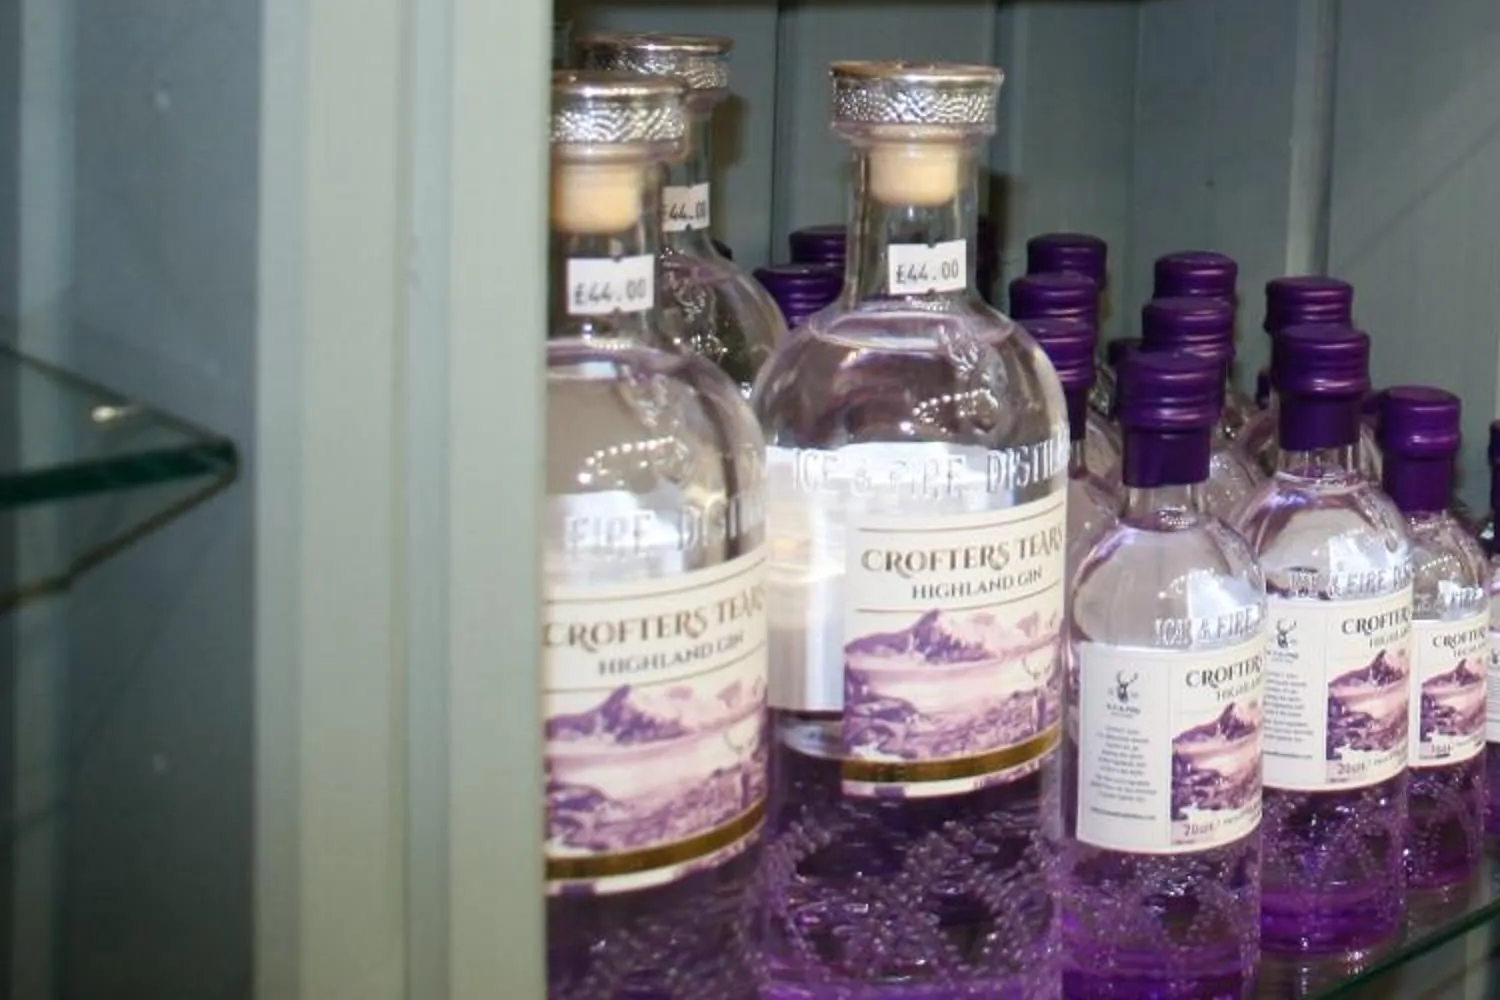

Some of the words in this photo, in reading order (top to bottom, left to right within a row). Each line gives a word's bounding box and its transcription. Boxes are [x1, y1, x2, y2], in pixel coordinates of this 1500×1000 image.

[894, 256, 960, 283] £44.00
[574, 275, 648, 305] £44.00
[861, 543, 1011, 580] CROFTERS
[1016, 523, 1064, 562] TEARS
[911, 575, 1014, 601] HIGHLAND
[1017, 565, 1043, 589] GIN
[543, 607, 708, 653] CROFTERS
[1216, 605, 1256, 640] FIRE
[598, 640, 714, 677] HIGHLAND
[716, 630, 745, 653] GIN
